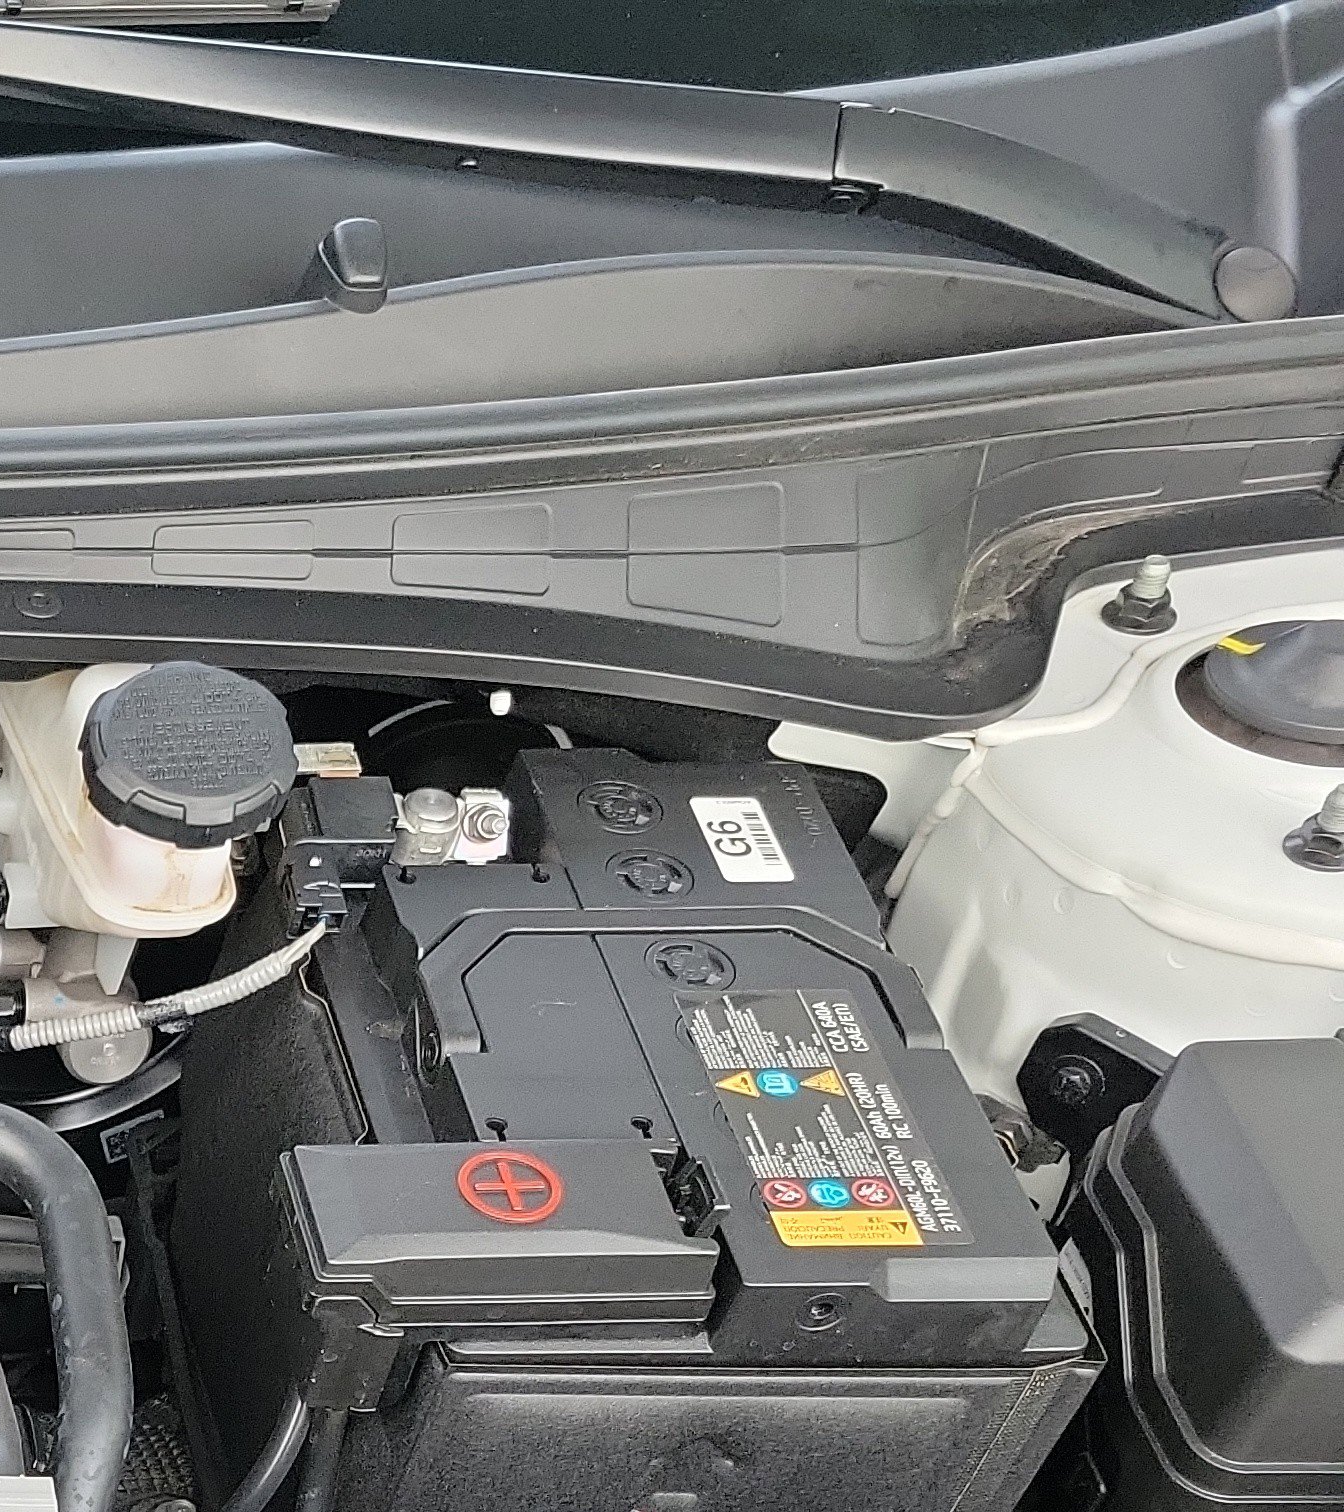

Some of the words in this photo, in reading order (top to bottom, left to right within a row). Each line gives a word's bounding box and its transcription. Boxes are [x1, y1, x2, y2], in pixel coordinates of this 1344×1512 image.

[707, 821, 752, 857] G6
[812, 1001, 838, 1029] 640A
[830, 1027, 849, 1052] CCA
[845, 1072, 875, 1109] (20HR)
[881, 1083, 902, 1120] 100min
[866, 1110, 893, 1139] 60Ah
[895, 1121, 913, 1139] RC
[911, 1159, 962, 1233] 37110-F9620
